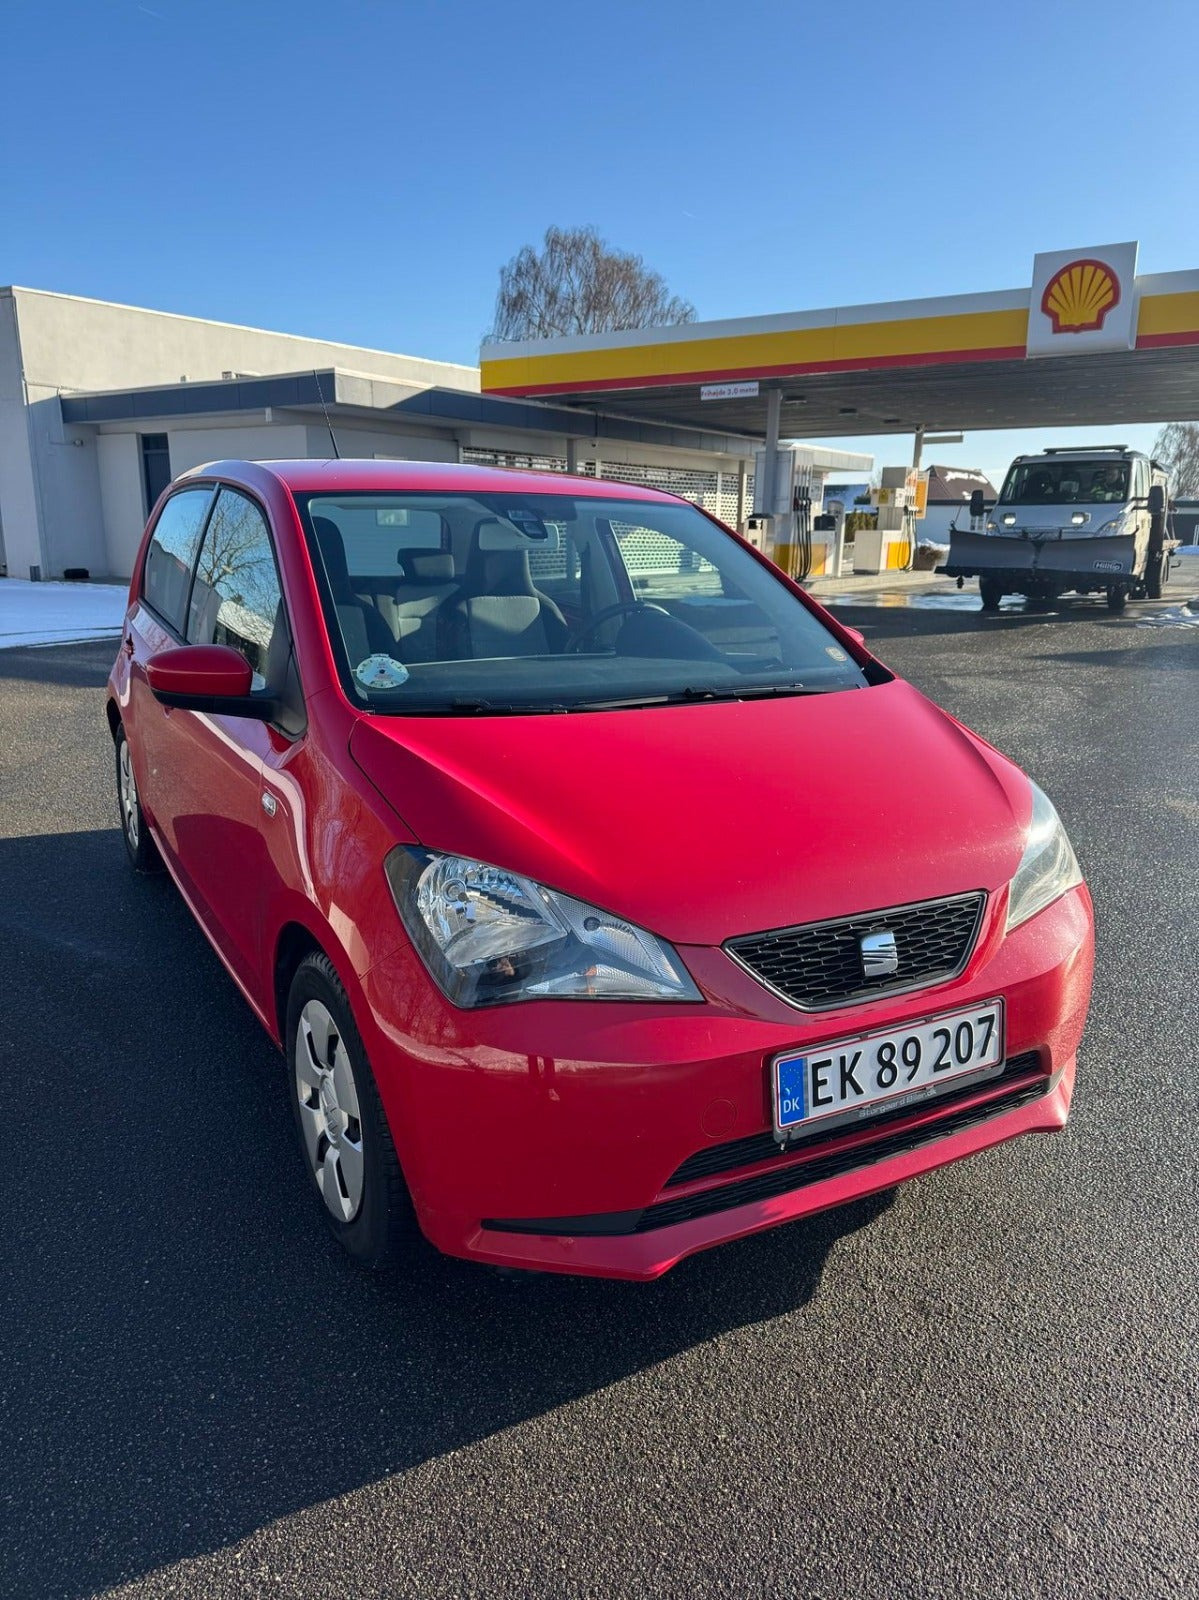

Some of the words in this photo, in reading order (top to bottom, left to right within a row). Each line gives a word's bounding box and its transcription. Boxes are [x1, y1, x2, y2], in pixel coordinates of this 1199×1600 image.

[811, 1050, 865, 1108] EK
[876, 1035, 922, 1089] 89
[932, 1013, 996, 1074] 207
[783, 1099, 800, 1114] DK
